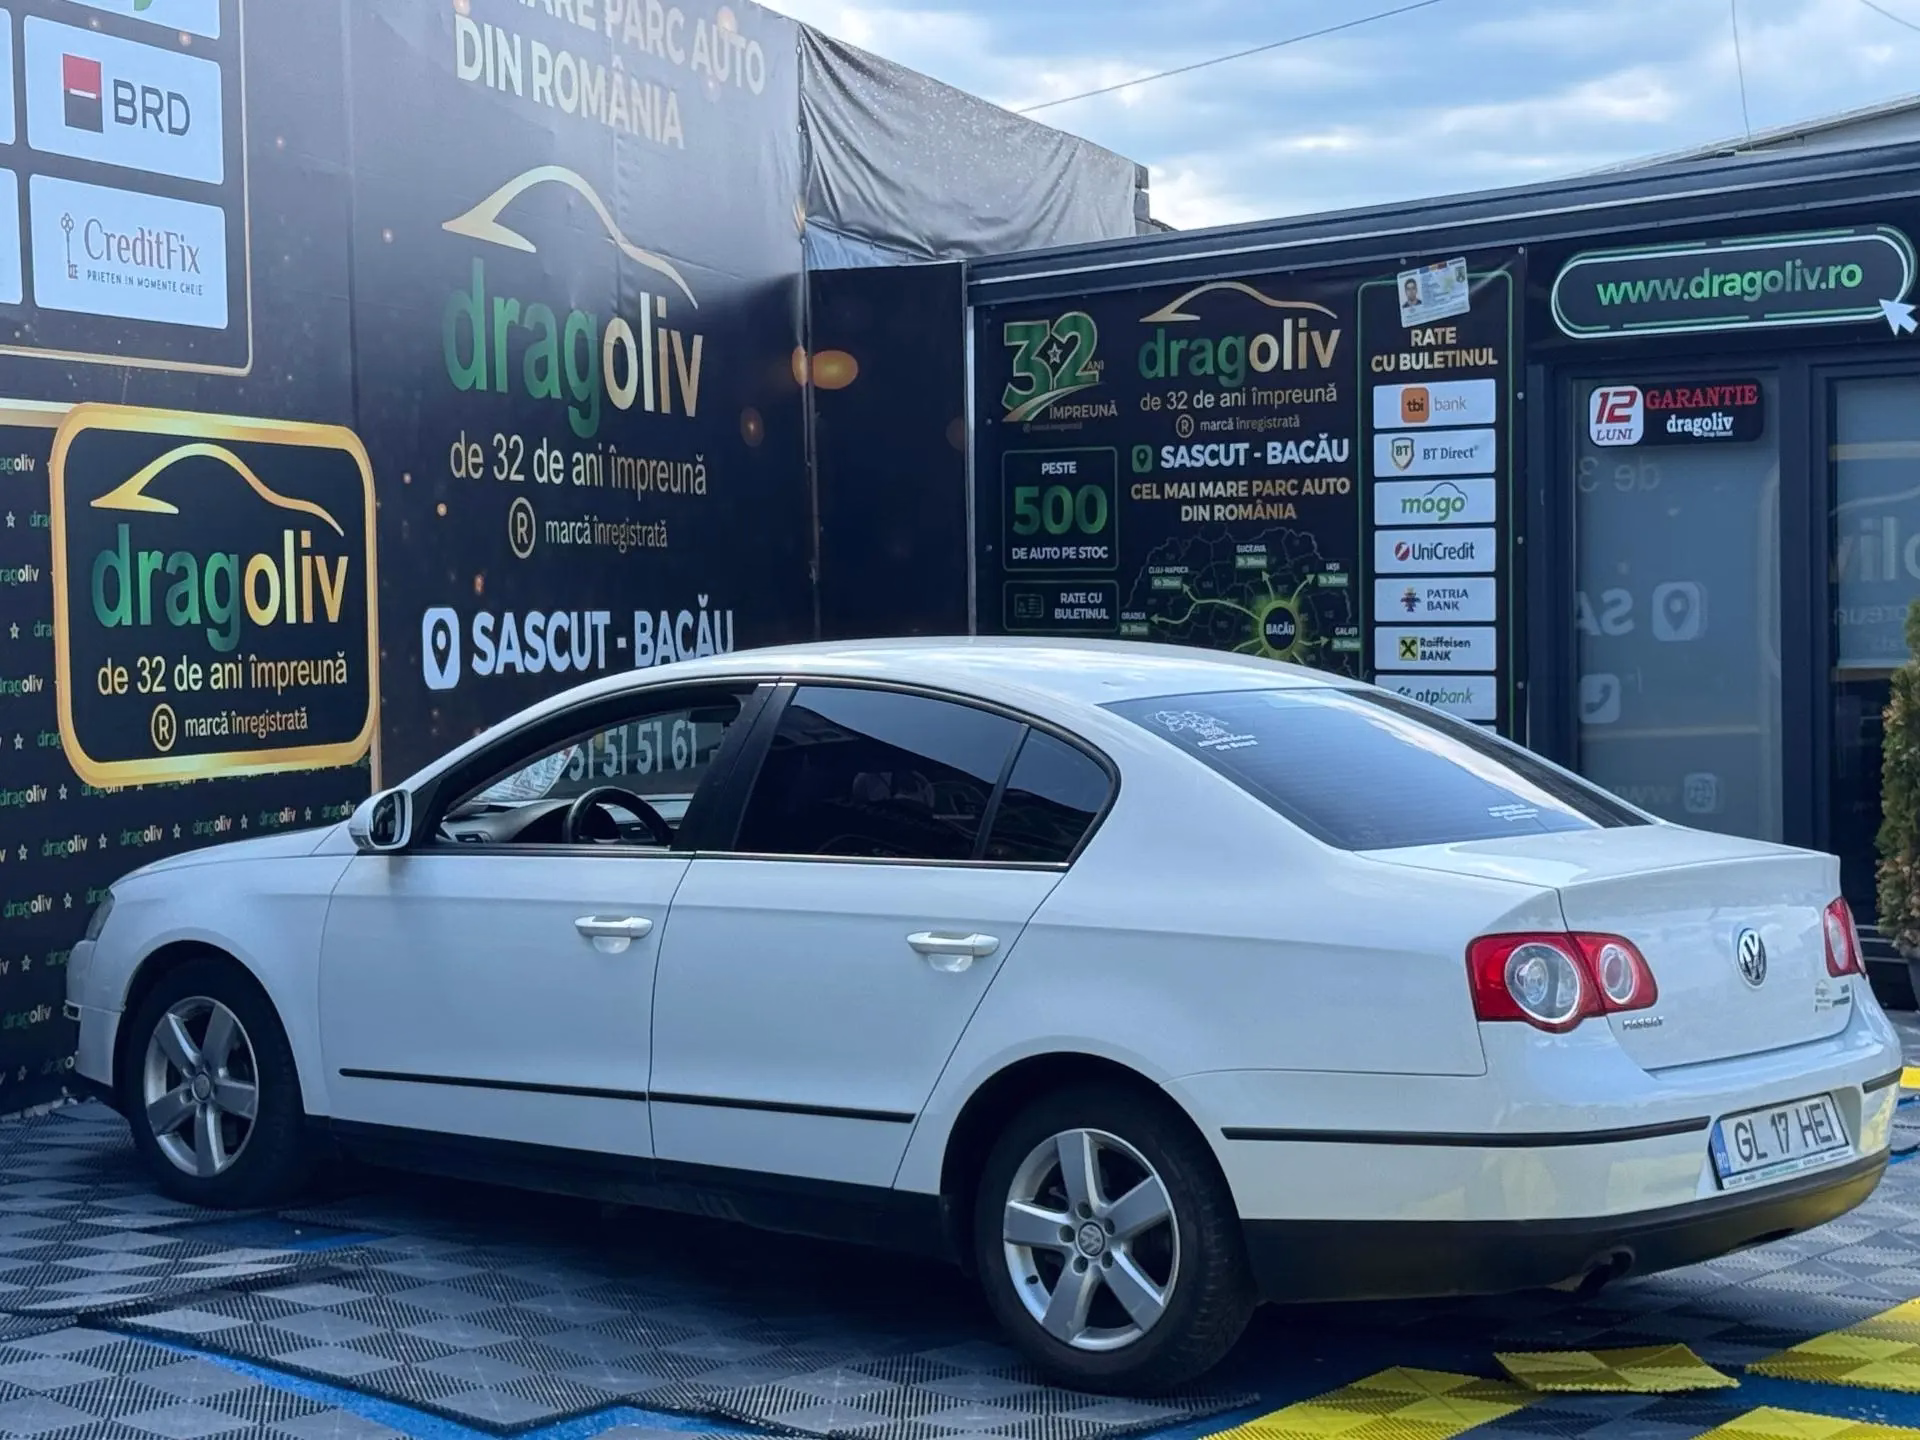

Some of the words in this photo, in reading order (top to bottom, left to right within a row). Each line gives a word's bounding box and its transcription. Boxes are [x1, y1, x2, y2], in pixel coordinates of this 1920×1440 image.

[606, 0, 686, 65] PARC
[691, 19, 765, 95] AUTO
[455, 14, 523, 96] DIN
[531, 40, 685, 149] ROMÂNIA
[113, 79, 190, 136] BRD
[84, 218, 200, 274] CreditFix
[87, 269, 121, 285] PRIETEN
[138, 278, 177, 293] MOMENTE
[1596, 259, 1863, 306] www.dragoliv.ro
[442, 257, 703, 438] dragoliv
[1411, 326, 1457, 347] RATE
[1002, 311, 1098, 411] 32
[1138, 317, 1341, 387] dragoliv
[1371, 354, 1395, 372] CU
[1399, 347, 1498, 371] BULETINUL
[1140, 393, 1161, 411] de
[1166, 391, 1188, 410] 32
[1193, 390, 1214, 408] de
[1220, 387, 1246, 407] ani
[1252, 382, 1337, 409] împreună
[1406, 397, 1424, 412] tbi
[1434, 397, 1468, 412] bank
[1595, 390, 1638, 424] 12
[1646, 385, 1759, 410] GARANTIE
[1200, 417, 1233, 431] marcă
[1236, 414, 1300, 433] înregistrată
[1596, 428, 1633, 441] LUNI
[1666, 411, 1734, 437] dragoliv
[1160, 442, 1249, 468] SASCUT
[1266, 433, 1349, 465] BACĂU
[1395, 445, 1409, 456] BT
[1423, 448, 1438, 460] BT
[451, 431, 483, 480] de
[494, 433, 525, 482] 32
[533, 437, 564, 484] de
[572, 443, 603, 487] ani
[611, 445, 706, 500] împreună
[1041, 461, 1077, 475] PESTE
[1131, 484, 1161, 500] CEL
[1164, 482, 1196, 499] MAI
[1200, 481, 1248, 498] MARE
[1252, 479, 1298, 497] PARC
[1301, 477, 1350, 495] AUTO
[1012, 485, 1108, 535] 500
[1181, 506, 1210, 522] DIN
[1214, 500, 1297, 520] ROMÂNIA
[1401, 497, 1465, 521] mogo
[545, 515, 591, 544] marcă
[594, 517, 668, 553] înregistrată
[1012, 548, 1028, 559] DE
[1029, 547, 1060, 559] AUTO
[1062, 547, 1077, 559] PE
[1078, 546, 1108, 558] STOC
[1412, 542, 1475, 560] UniCredit
[91, 524, 348, 651] dragoliv
[1060, 593, 1086, 604] RATE
[1087, 592, 1102, 603] CU
[1427, 589, 1469, 599] PATRIA
[1054, 608, 1109, 620] BULETINUL
[1427, 601, 1460, 611] BANK
[472, 611, 611, 676] SASCUT
[633, 595, 733, 668] BACĂU
[1265, 621, 1295, 635] BACĂU
[1420, 636, 1471, 648] Raiffeisen
[1420, 651, 1452, 661] BANK
[98, 658, 128, 694] de
[137, 656, 166, 693] 32
[174, 655, 203, 691] de
[210, 654, 243, 689] ani
[251, 651, 348, 695] împreună
[1416, 686, 1473, 705] otpbank
[185, 711, 229, 738] marcă
[232, 709, 308, 739] înregistrată
[636, 721, 663, 774] 51
[671, 718, 697, 771] 61
[42, 835, 88, 859] dragoliv
[120, 825, 163, 847] dragoliv
[193, 815, 232, 836] dragoliv
[260, 806, 297, 827] dragoliv
[4, 894, 52, 919] dragoliv
[3, 1004, 52, 1030] dragoliv
[1735, 1119, 1768, 1162] GL
[1770, 1112, 1790, 1154] 17
[1795, 1102, 1837, 1148] HEI
